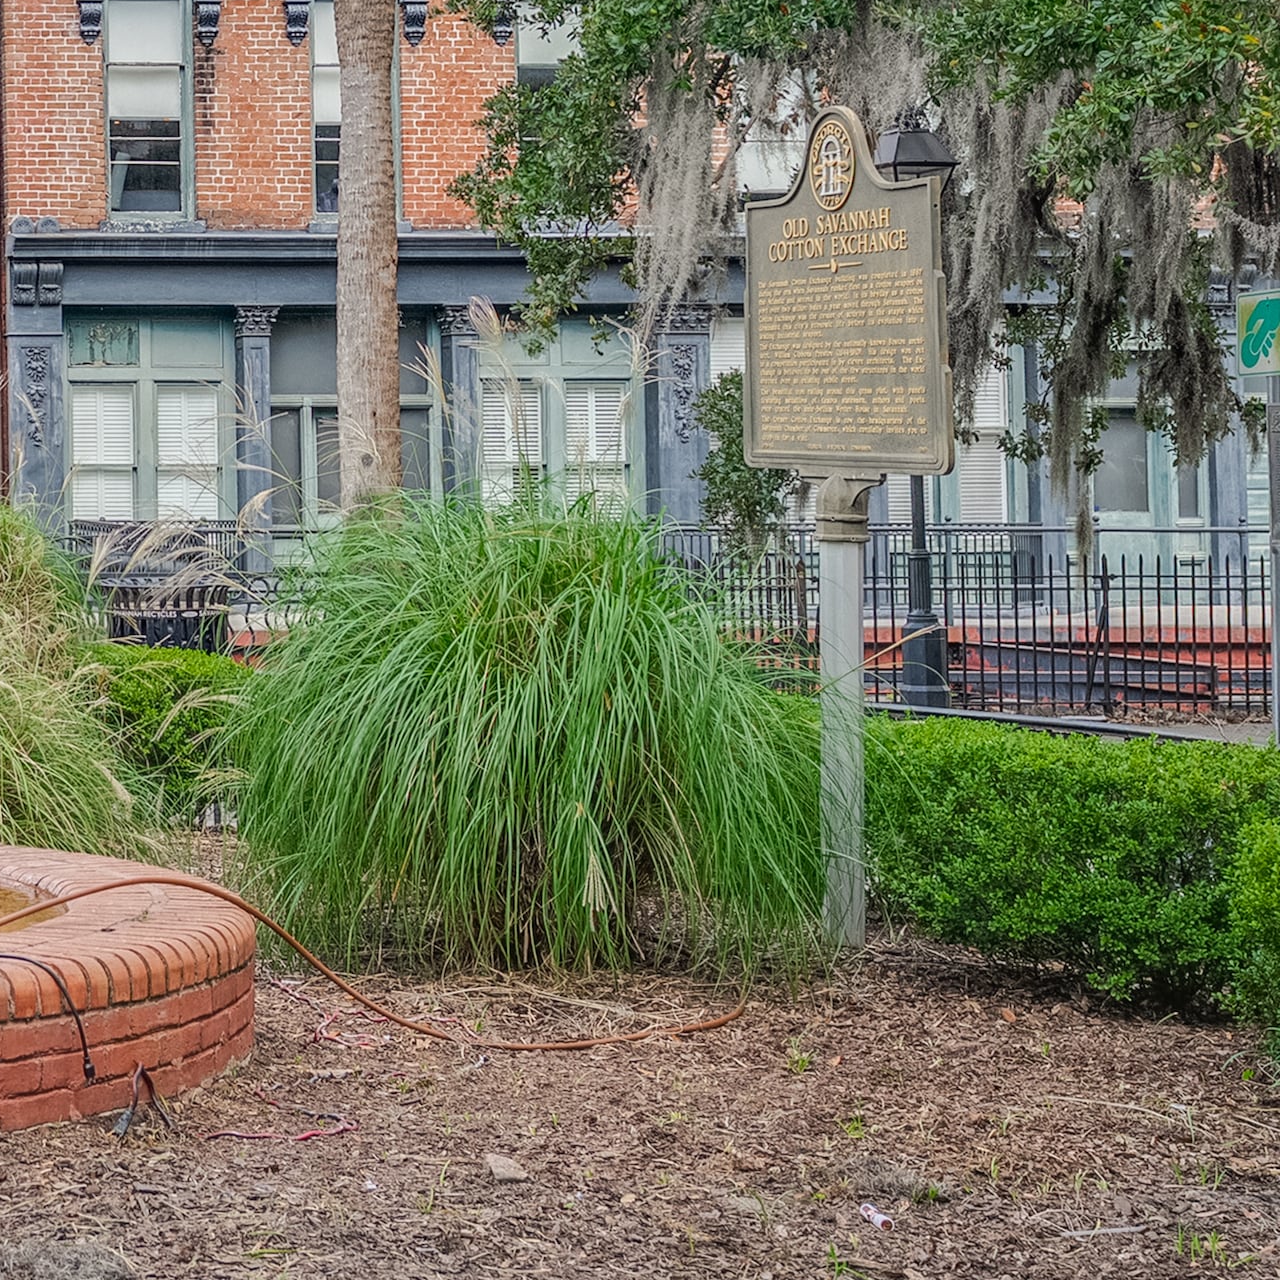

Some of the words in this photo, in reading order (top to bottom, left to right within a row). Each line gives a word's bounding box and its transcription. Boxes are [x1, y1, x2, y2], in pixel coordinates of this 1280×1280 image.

[812, 123, 851, 164] GEORGIA
[782, 217, 810, 239] OLD
[815, 207, 891, 236] SAVANNAH
[768, 238, 825, 262] COTTON
[831, 228, 908, 256] EXCHANGE
[142, 610, 178, 619] RECYCLES
